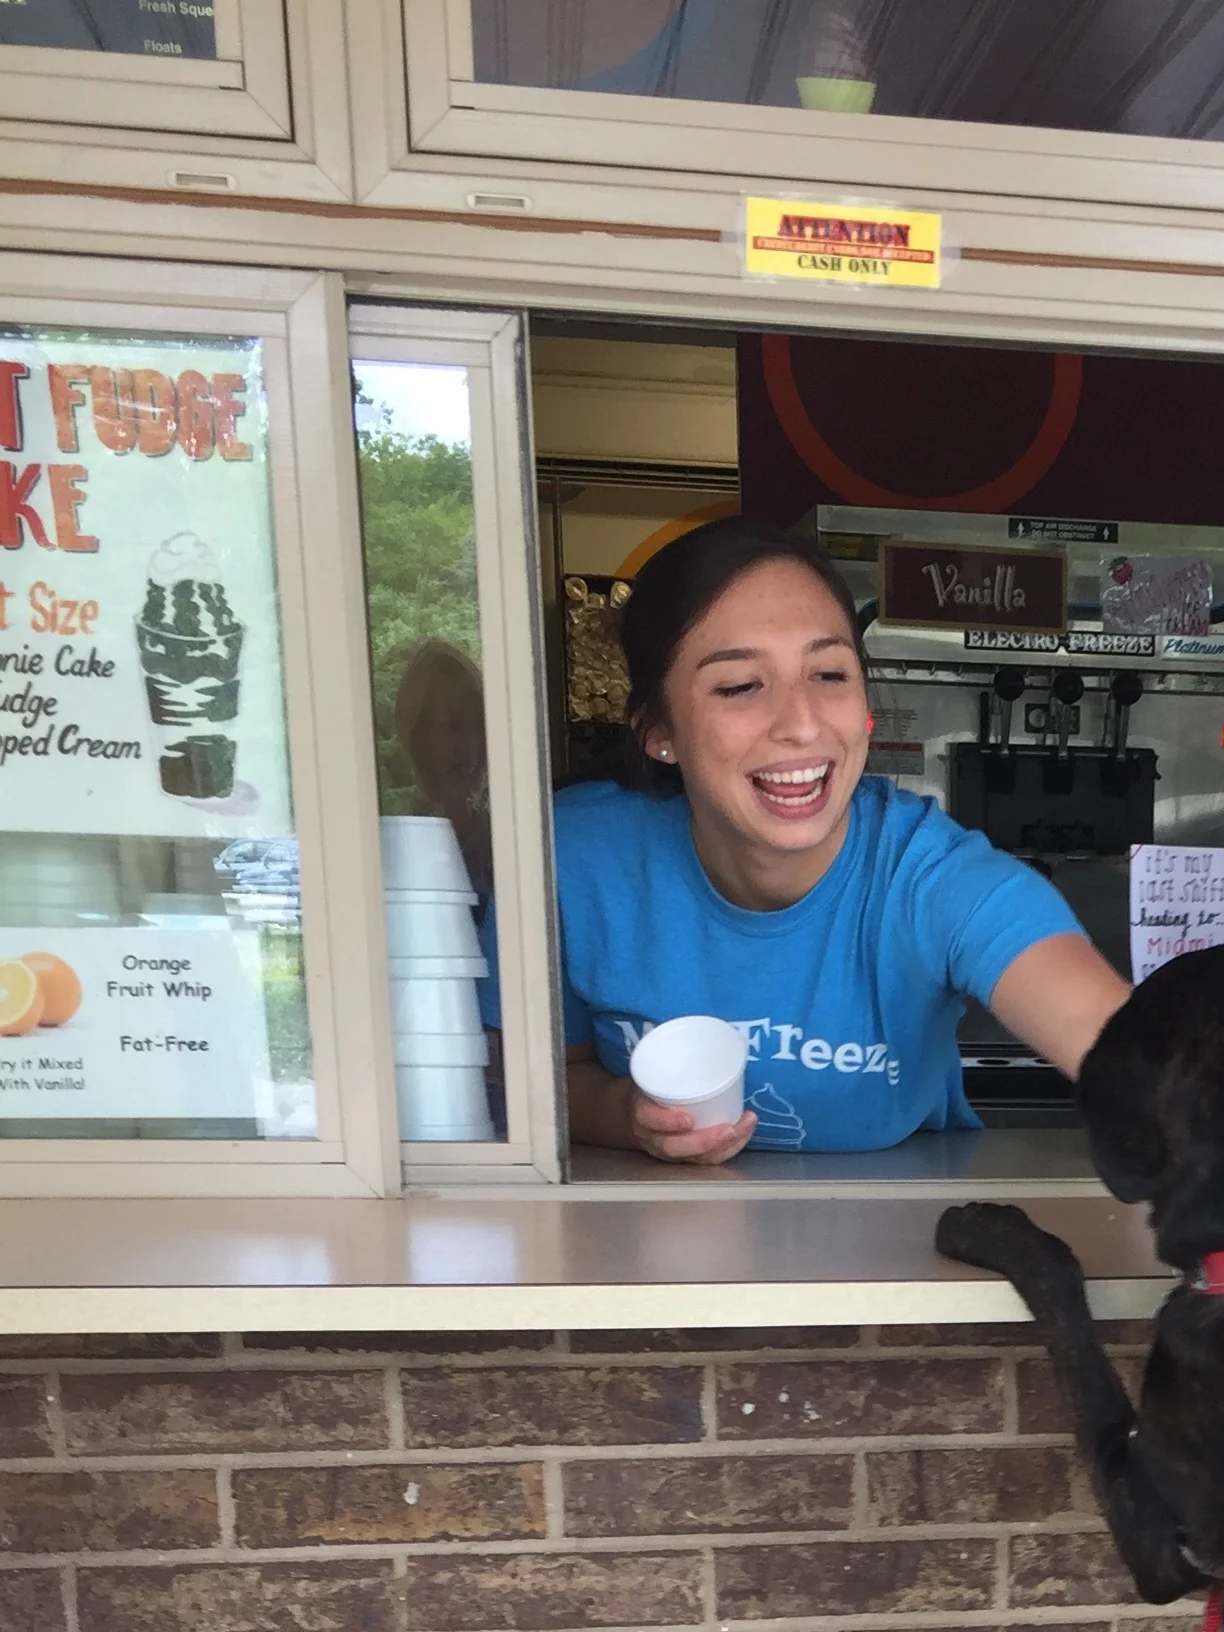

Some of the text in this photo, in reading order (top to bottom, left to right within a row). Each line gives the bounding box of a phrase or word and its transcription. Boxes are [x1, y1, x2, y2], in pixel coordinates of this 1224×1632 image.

[139, 0, 176, 14] Fresh
[144, 40, 182, 54] Floats
[777, 214, 910, 247] ATTENTION
[797, 254, 891, 275] CASH ONLY
[48, 364, 253, 461] FUDGE
[0, 460, 100, 552] KE
[921, 560, 1027, 614] Vanilla
[28, 581, 99, 635] Size
[967, 630, 1154, 656] ELECTRO FREEZE
[0, 643, 116, 678] nie Cake
[58, 723, 143, 760] Cream
[1146, 849, 1214, 882] it's my
[1139, 879, 1175, 903] last
[1146, 933, 1214, 957] Miami
[122, 955, 193, 975] Orange
[106, 981, 213, 1001] Fruit Whip
[120, 1035, 210, 1052] Fat-Free
[730, 1018, 900, 1085] Freeze
[20, 1057, 32, 1070] it
[38, 1056, 84, 1070] Mixed
